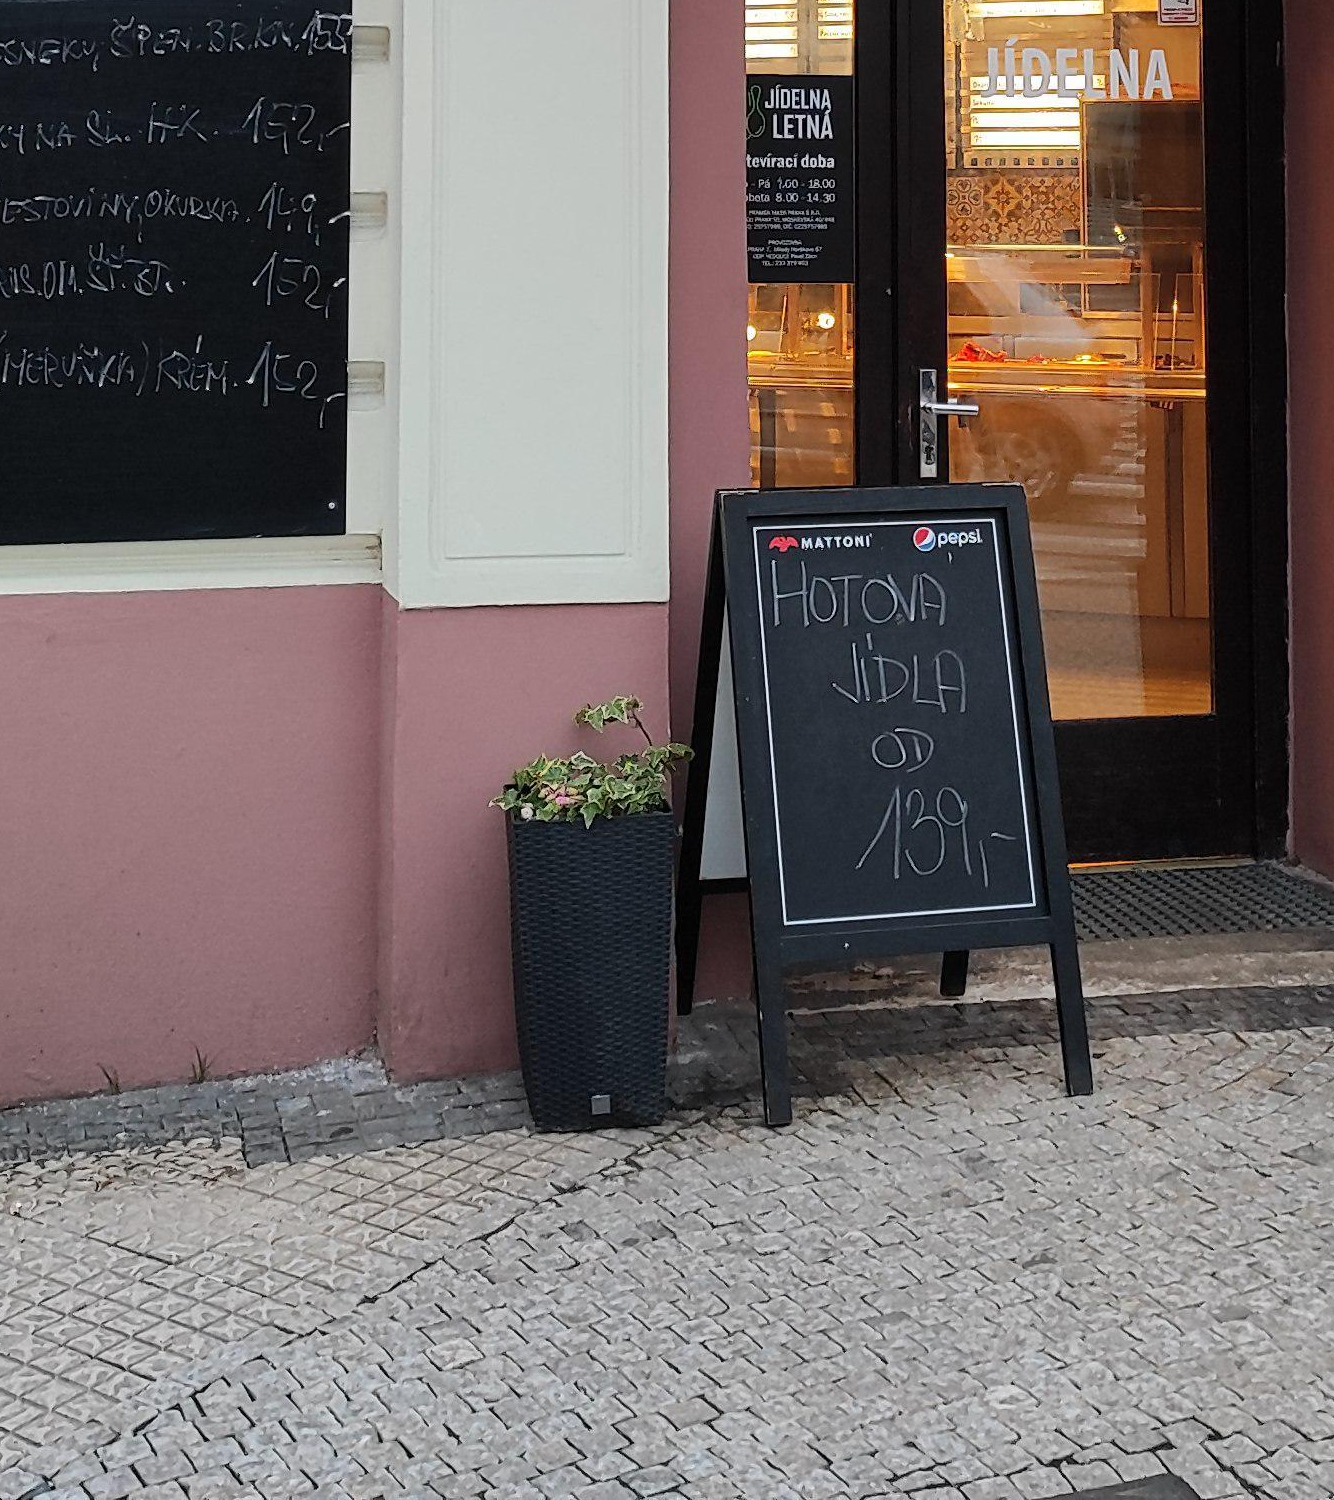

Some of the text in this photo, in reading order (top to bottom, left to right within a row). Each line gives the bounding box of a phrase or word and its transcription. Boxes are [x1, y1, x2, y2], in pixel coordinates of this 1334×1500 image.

[981, 37, 1173, 101] JÍDELNA
[764, 84, 832, 110] JÍDELNA
[772, 111, 834, 139] LETNÁ
[746, 153, 835, 169] tevírací doba
[800, 534, 870, 550] MATTONI
[832, 633, 967, 713] JÍDLA
[872, 728, 934, 773] OD
